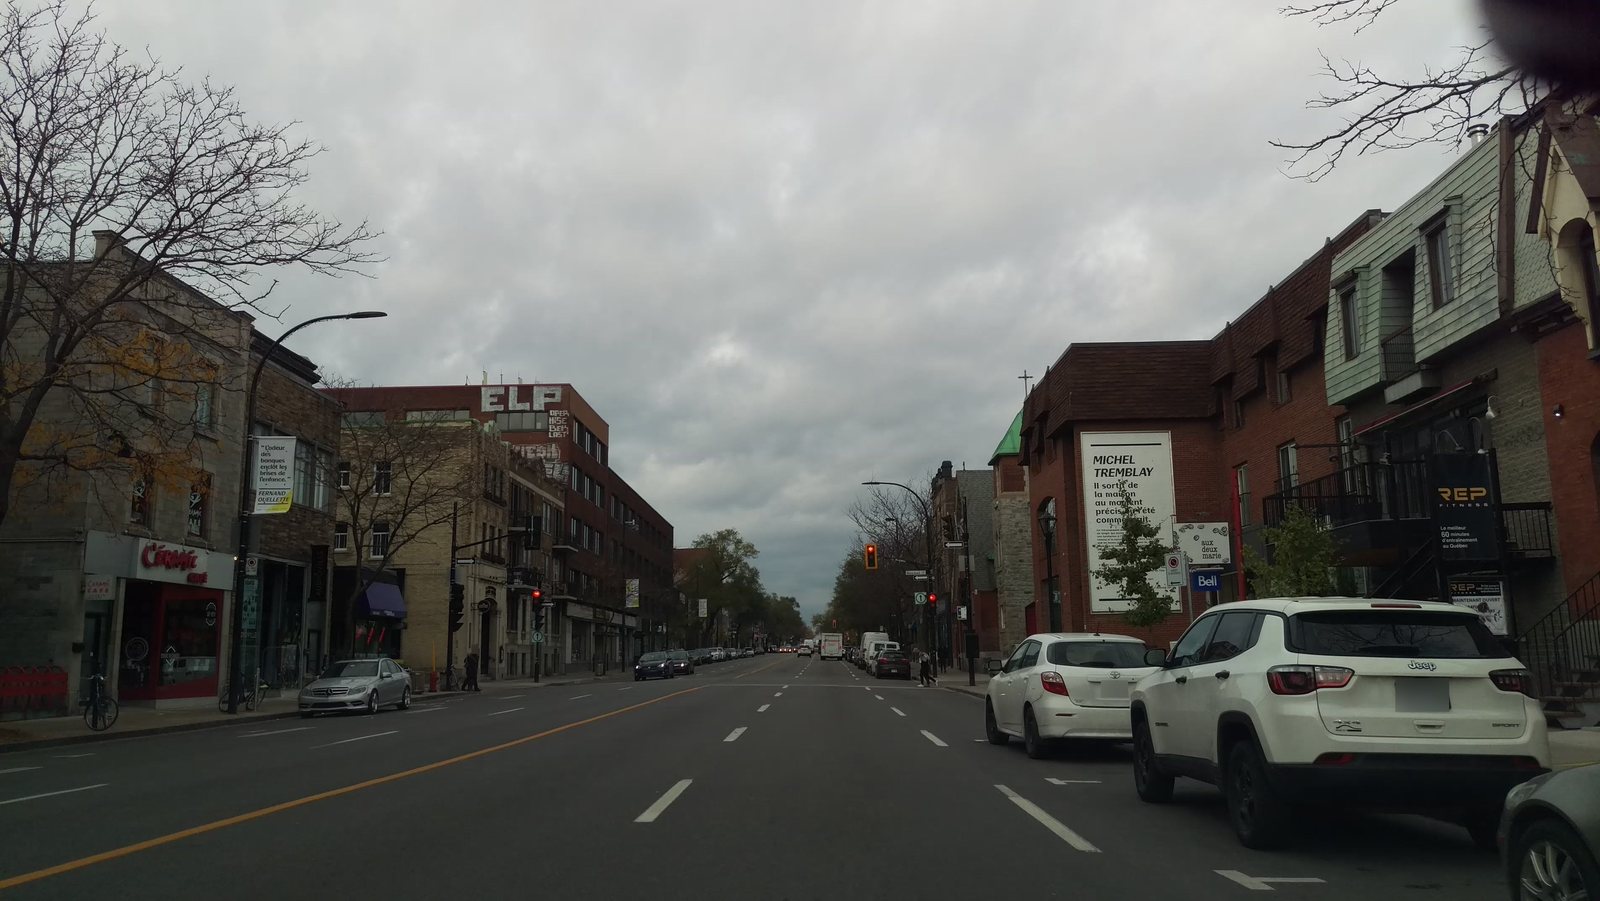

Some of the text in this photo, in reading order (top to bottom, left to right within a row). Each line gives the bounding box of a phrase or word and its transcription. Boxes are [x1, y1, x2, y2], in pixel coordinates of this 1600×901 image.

[1093, 455, 1136, 465] MICHEL
[1094, 467, 1154, 478] TREMBLAY
[1128, 481, 1139, 489] de
[1438, 487, 1488, 501] REP
[1198, 575, 1218, 587] Bell
[1408, 660, 1437, 671] Jeep
